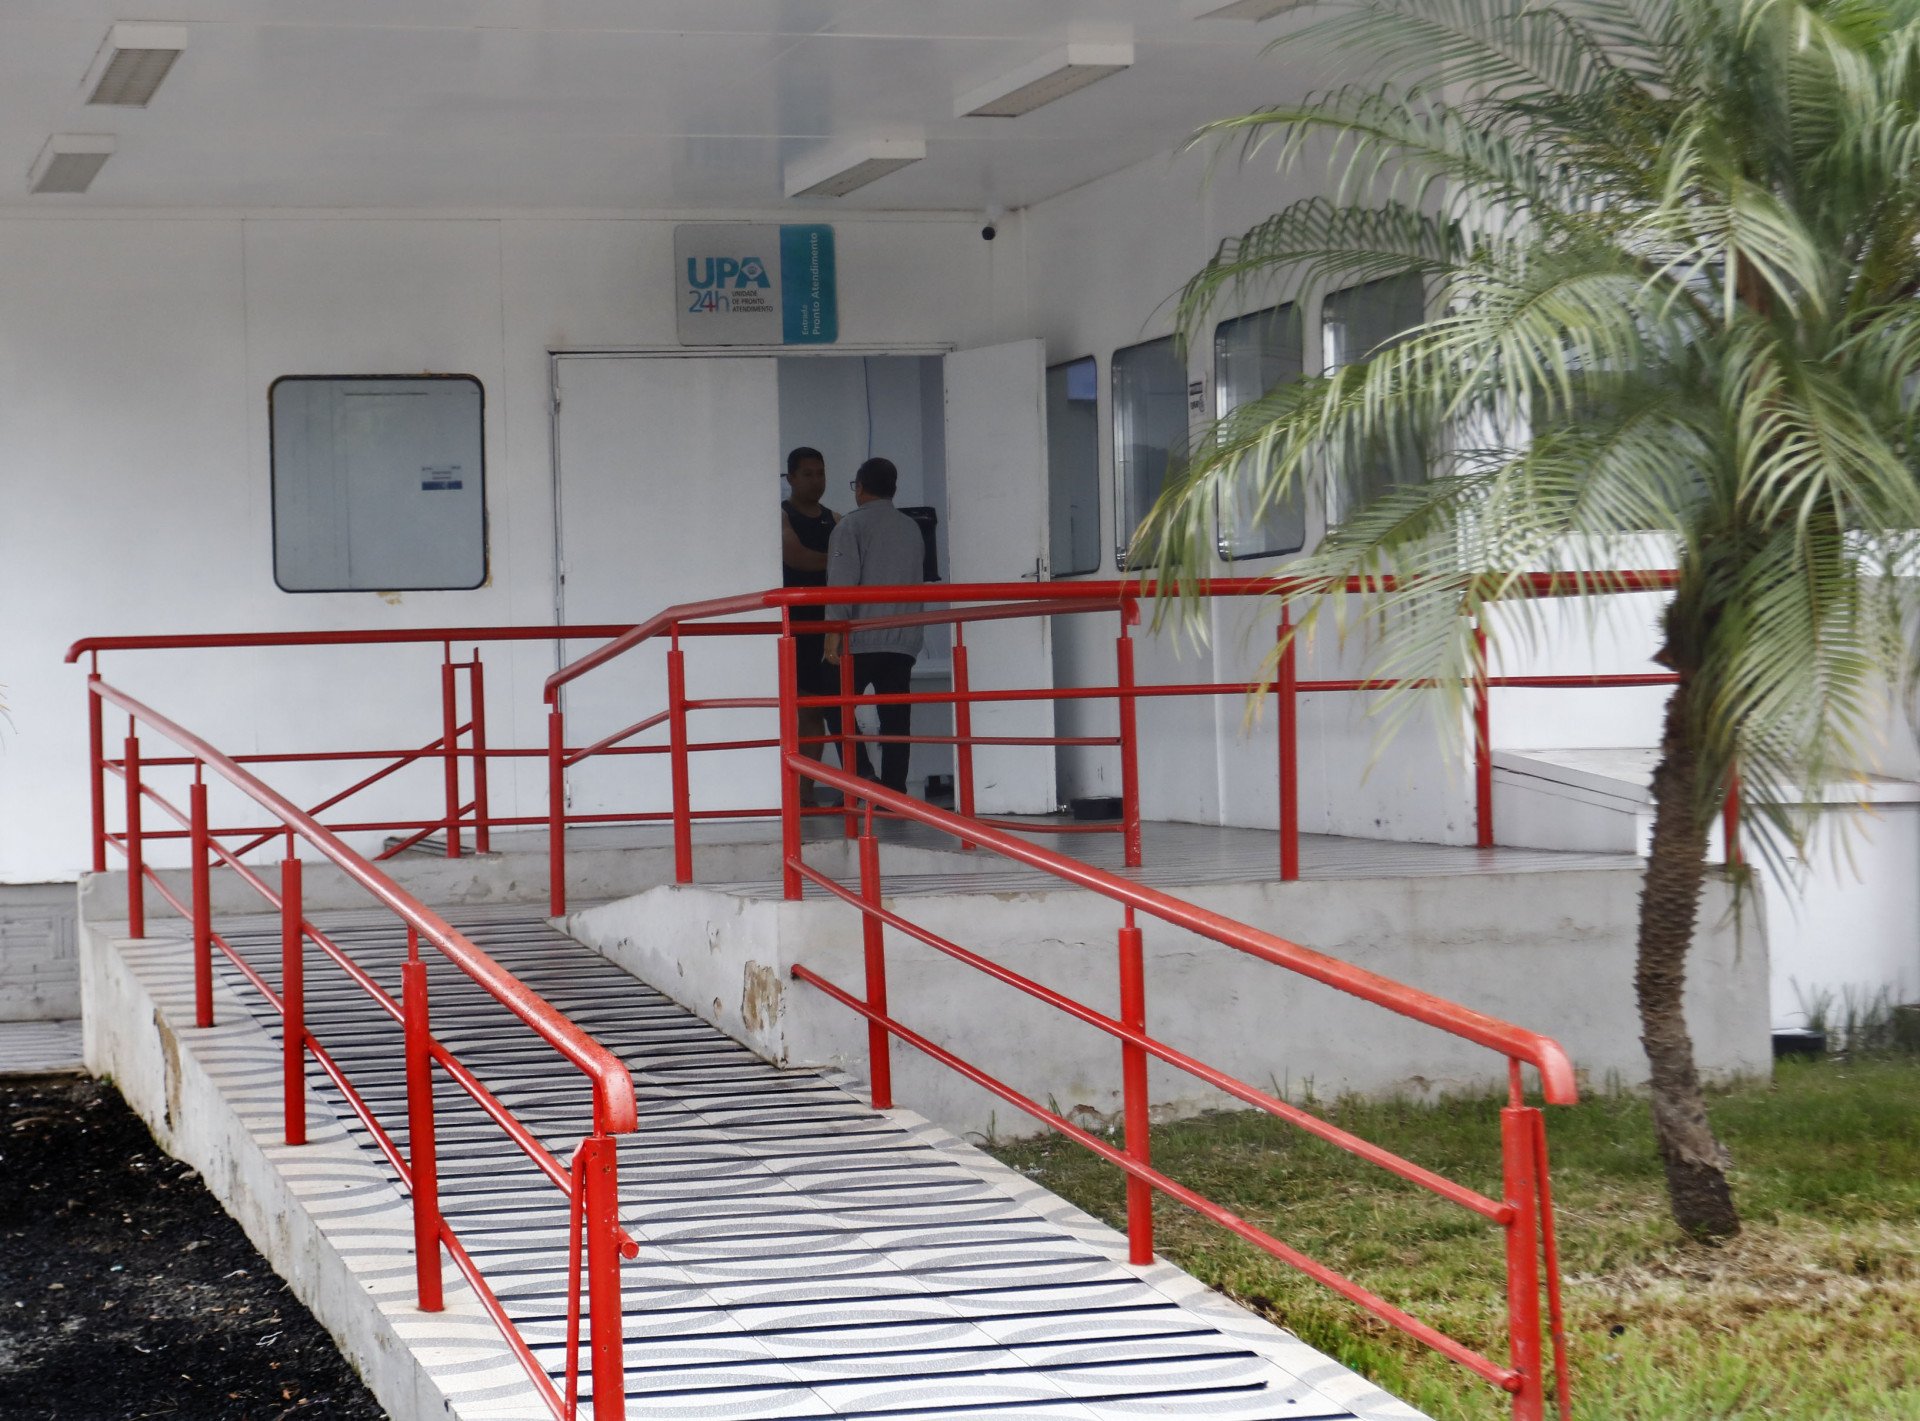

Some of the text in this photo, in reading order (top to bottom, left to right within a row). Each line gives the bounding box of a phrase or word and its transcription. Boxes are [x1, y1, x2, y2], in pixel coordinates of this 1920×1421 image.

[687, 256, 771, 289] UPA
[809, 232, 821, 335] Pronto Atendimento
[688, 290, 730, 313] 24h
[732, 305, 774, 313] ATENDIMENTO
[801, 304, 809, 335] Entrada
